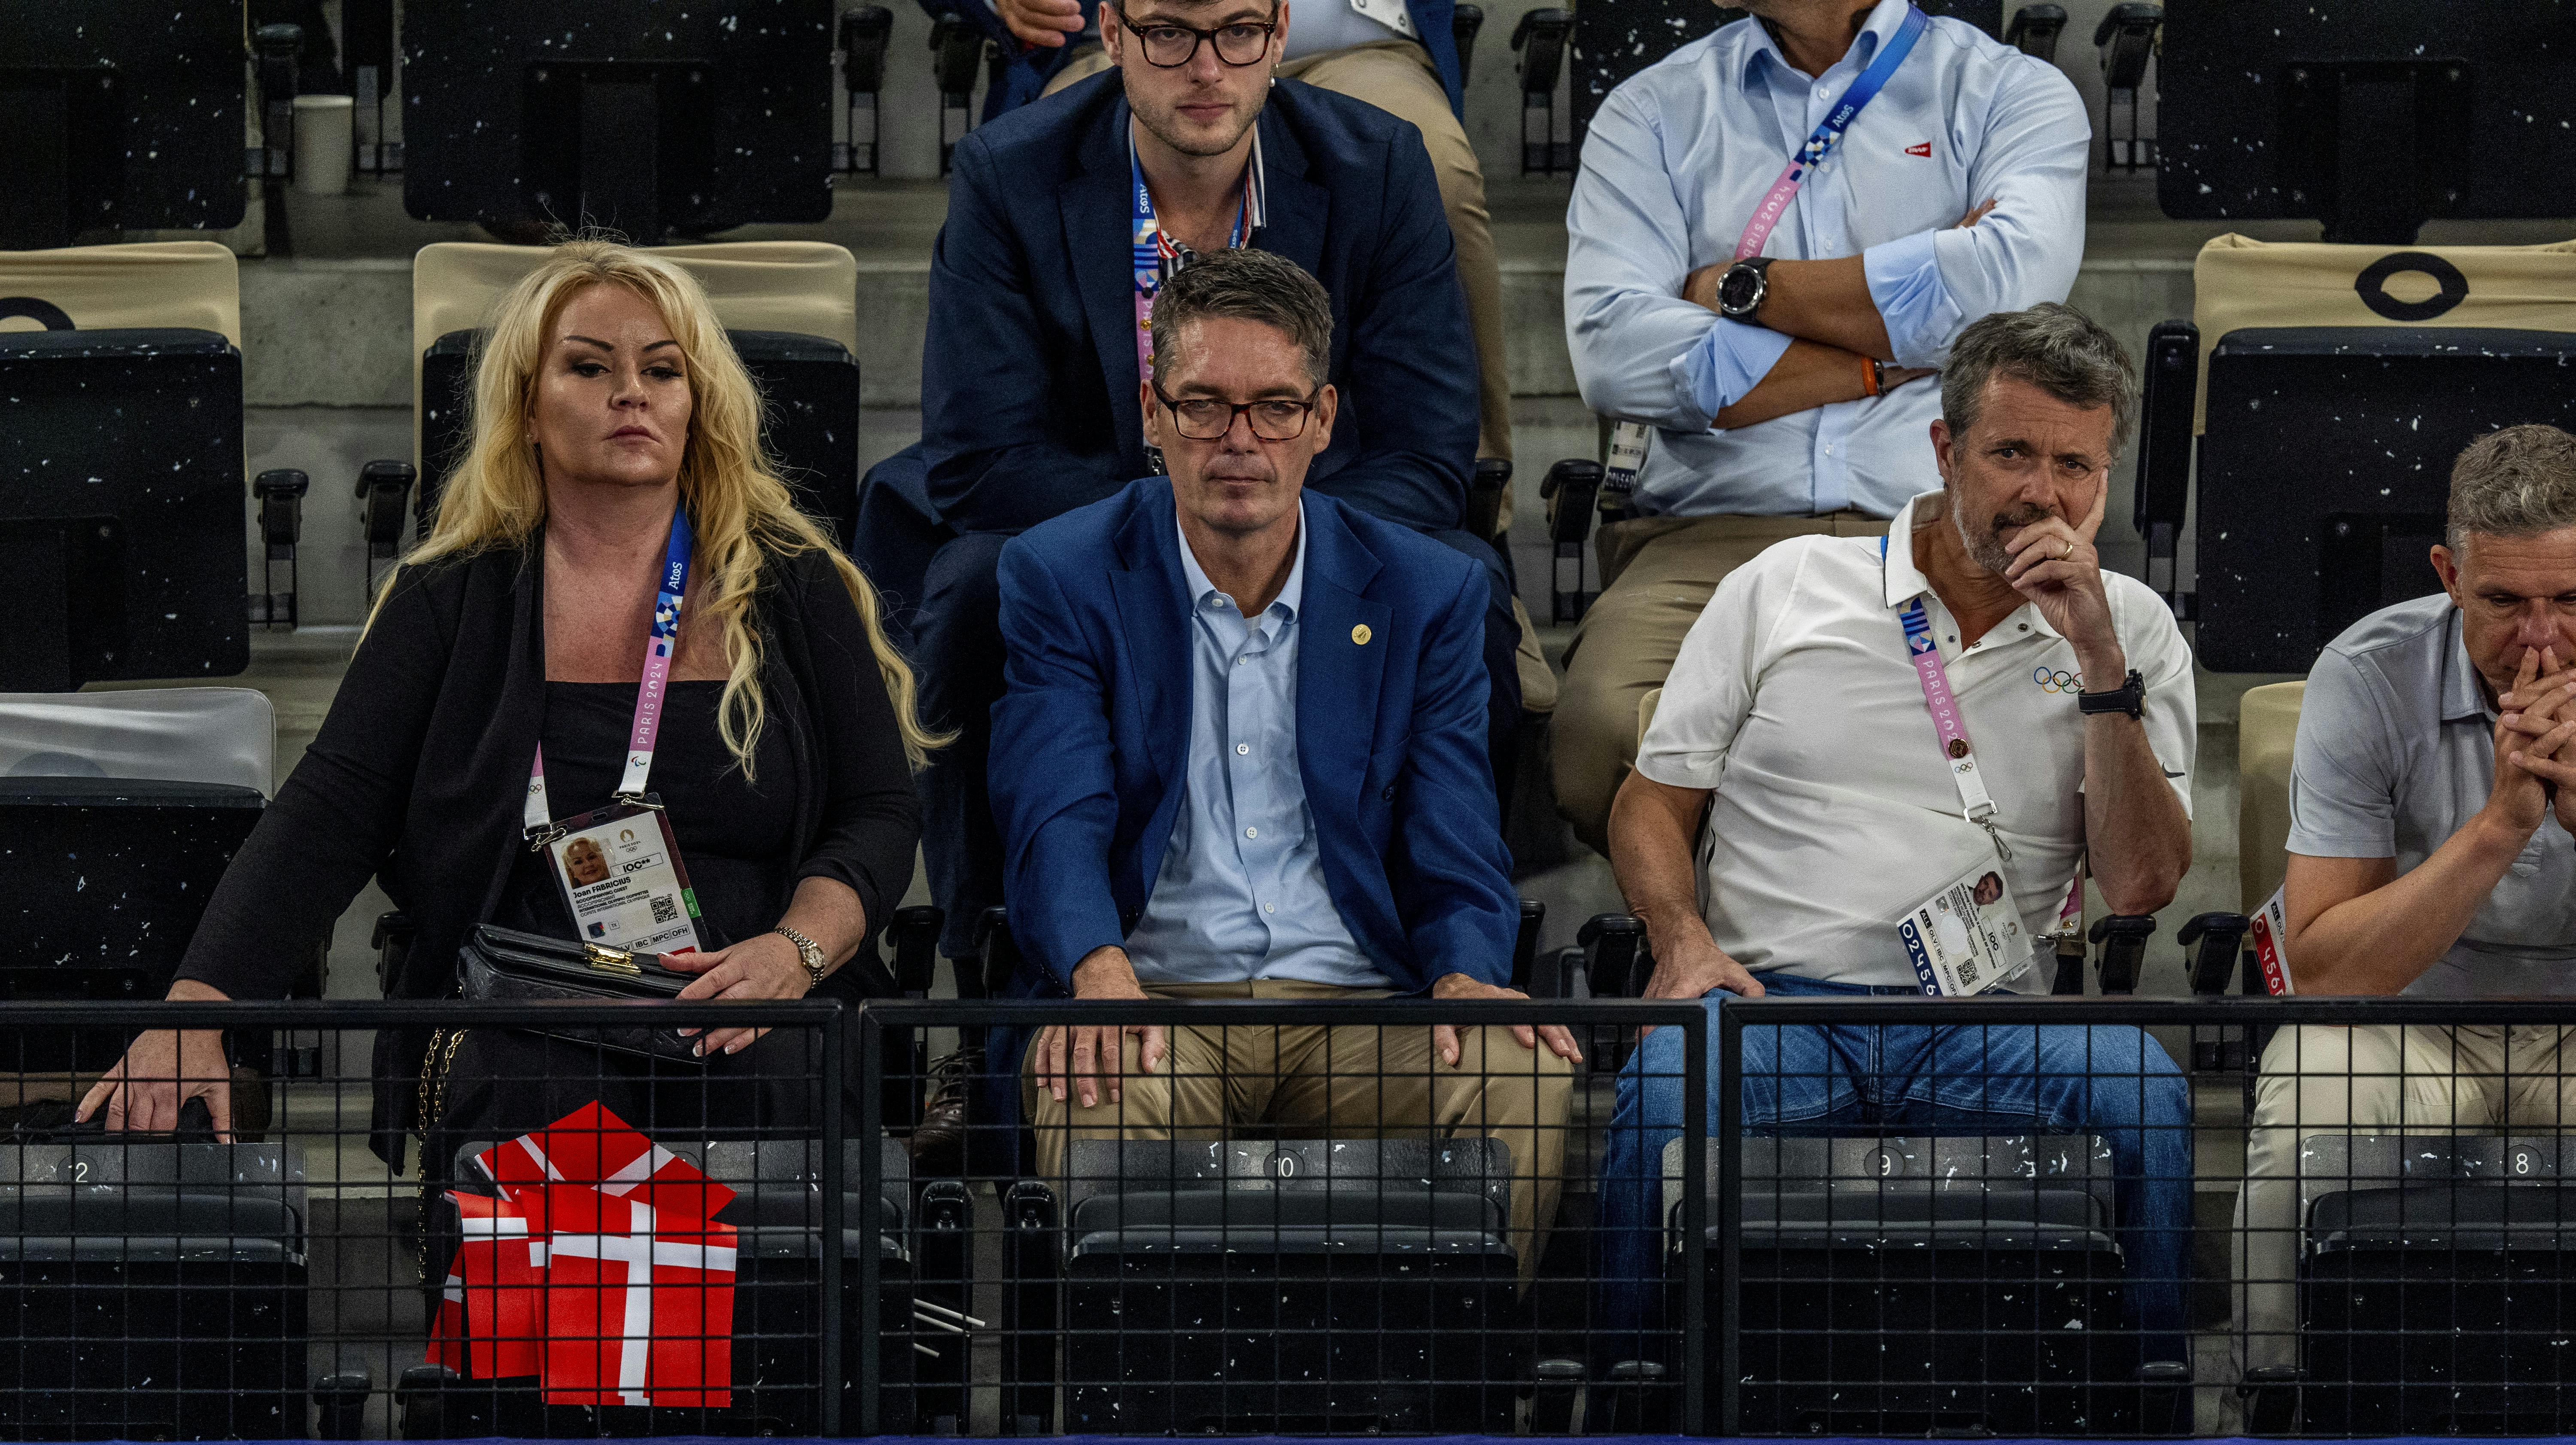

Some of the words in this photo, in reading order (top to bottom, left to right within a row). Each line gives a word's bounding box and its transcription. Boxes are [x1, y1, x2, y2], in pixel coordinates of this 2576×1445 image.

[1832, 105, 1854, 127] Atos
[1140, 183, 1150, 213] Atos
[1743, 223, 1765, 257] ARIS
[1761, 186, 1791, 220] 2024
[668, 562, 683, 590] Atos
[638, 703, 655, 744] PARIS
[647, 663, 662, 698] 2024
[1923, 660, 1945, 705] PARIS
[1939, 709, 1959, 742] 202
[572, 888, 591, 898] Joan
[591, 876, 631, 893] FABRICIUS
[575, 890, 613, 904] ACCOMPANYING
[577, 894, 615, 909] ACCOMPAGNANT
[578, 901, 608, 913] INTERNATIONAL
[607, 896, 626, 904] OLYMPIC
[626, 889, 649, 899] COMMITTEE
[596, 900, 626, 912] INTERNATIONAL
[626, 893, 650, 904] OLYMPIQUE
[635, 939, 648, 948] IBC
[652, 933, 669, 943] MPC
[671, 927, 688, 937] OFH
[1921, 912, 1930, 926] ALL
[1928, 929, 1938, 944] OLV
[1936, 948, 1944, 961] IBC
[1942, 964, 1951, 981] MPC
[1977, 925, 1986, 941] KONGE
[1986, 947, 1996, 969] DENMARK
[1987, 931, 2000, 952] IOC
[2516, 1153, 2529, 1174] 8
